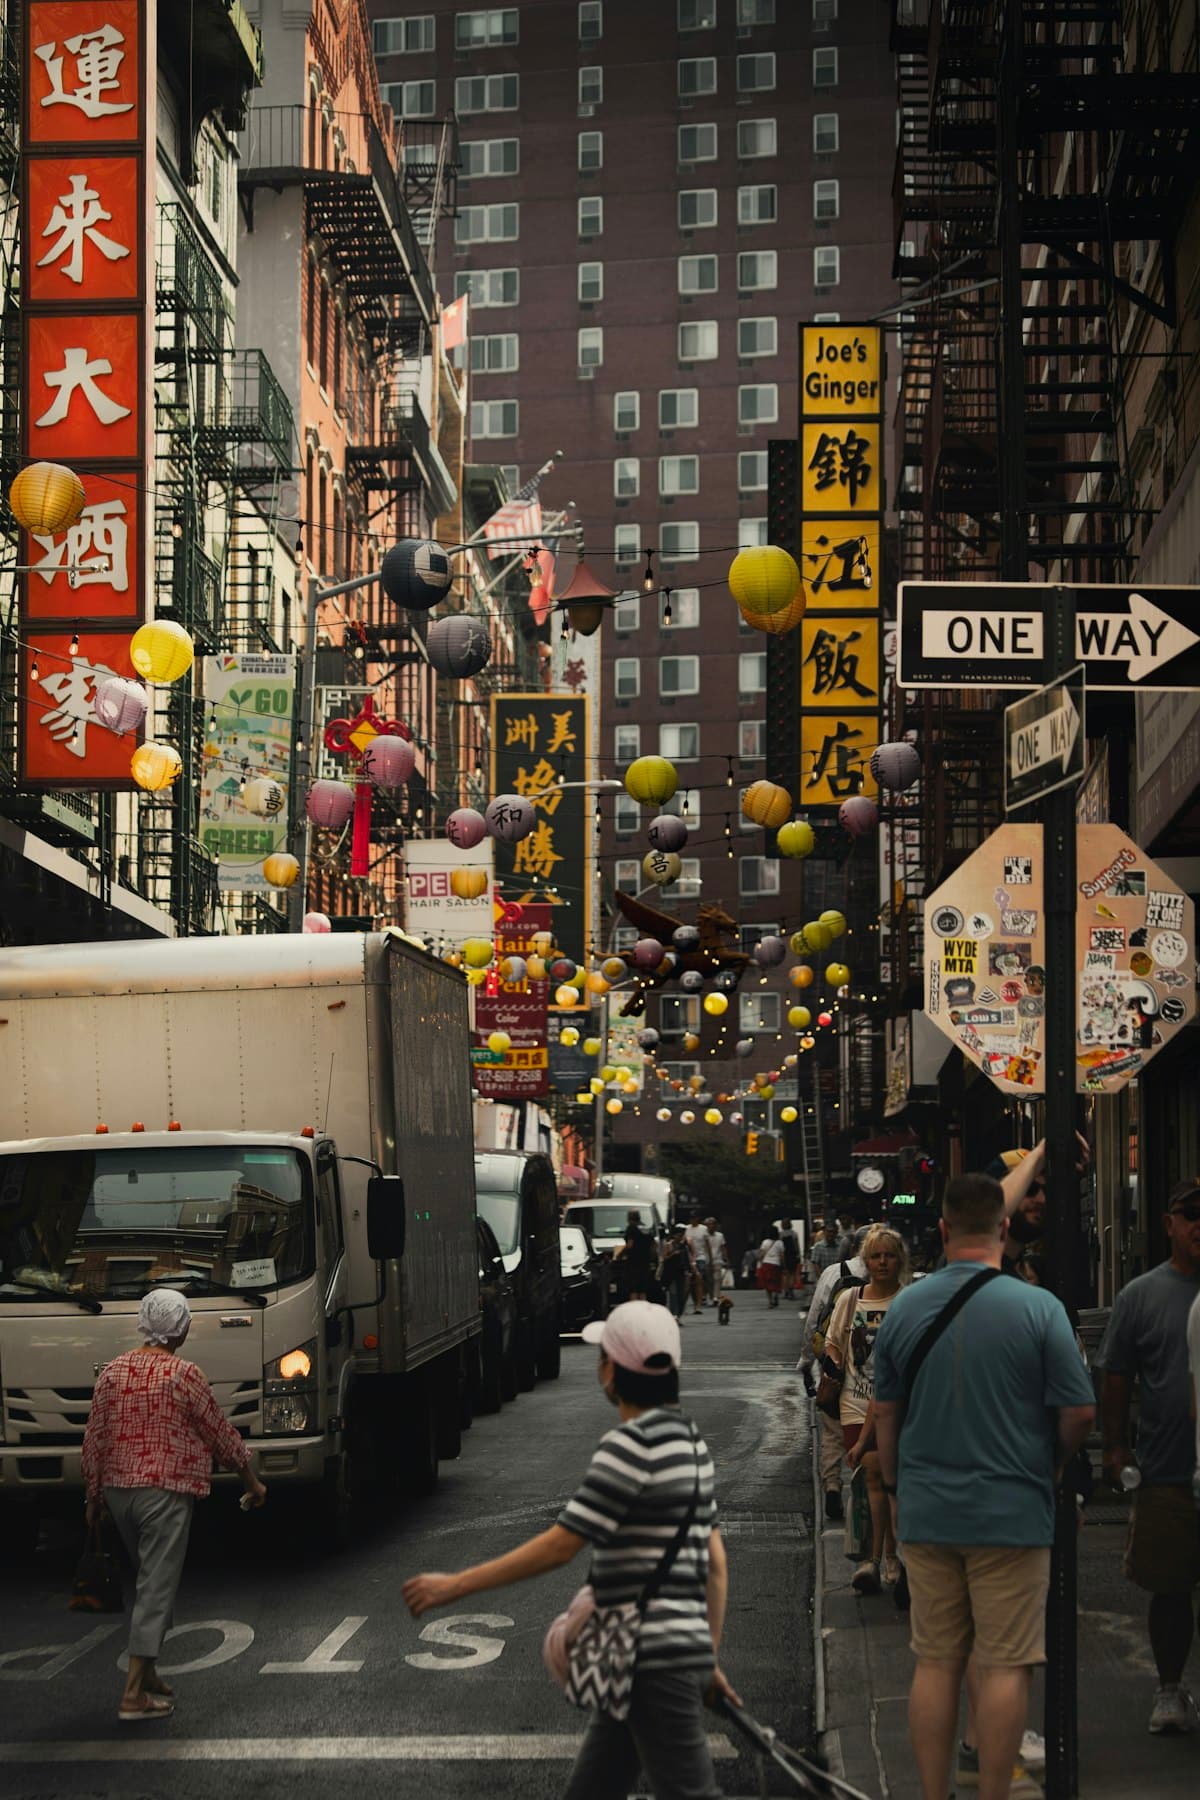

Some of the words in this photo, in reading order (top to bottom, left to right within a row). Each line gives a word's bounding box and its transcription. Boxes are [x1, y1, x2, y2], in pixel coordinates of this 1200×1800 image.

[815, 335, 868, 364] Joe's
[32, 23, 135, 759] 運來大酒家
[805, 371, 878, 404] Ginger
[802, 428, 878, 798] 錦江飯店
[947, 616, 1034, 654] ONE
[1078, 619, 1170, 656] WAY
[255, 688, 288, 713] GO
[1017, 725, 1041, 771] ONE
[1049, 705, 1073, 754] WAY
[492, 803, 523, 830] 和
[203, 828, 274, 855] GREEN
[1081, 849, 1136, 898] Support
[409, 898, 441, 908] HAIR
[446, 897, 489, 907] SALON
[1148, 891, 1185, 908] MUTZ
[943, 939, 978, 958] WYDE
[944, 958, 975, 974] MTA
[495, 1013, 520, 1023] Color
[892, 1195, 917, 1205] ATM
[0, 1613, 516, 1682] STOP
